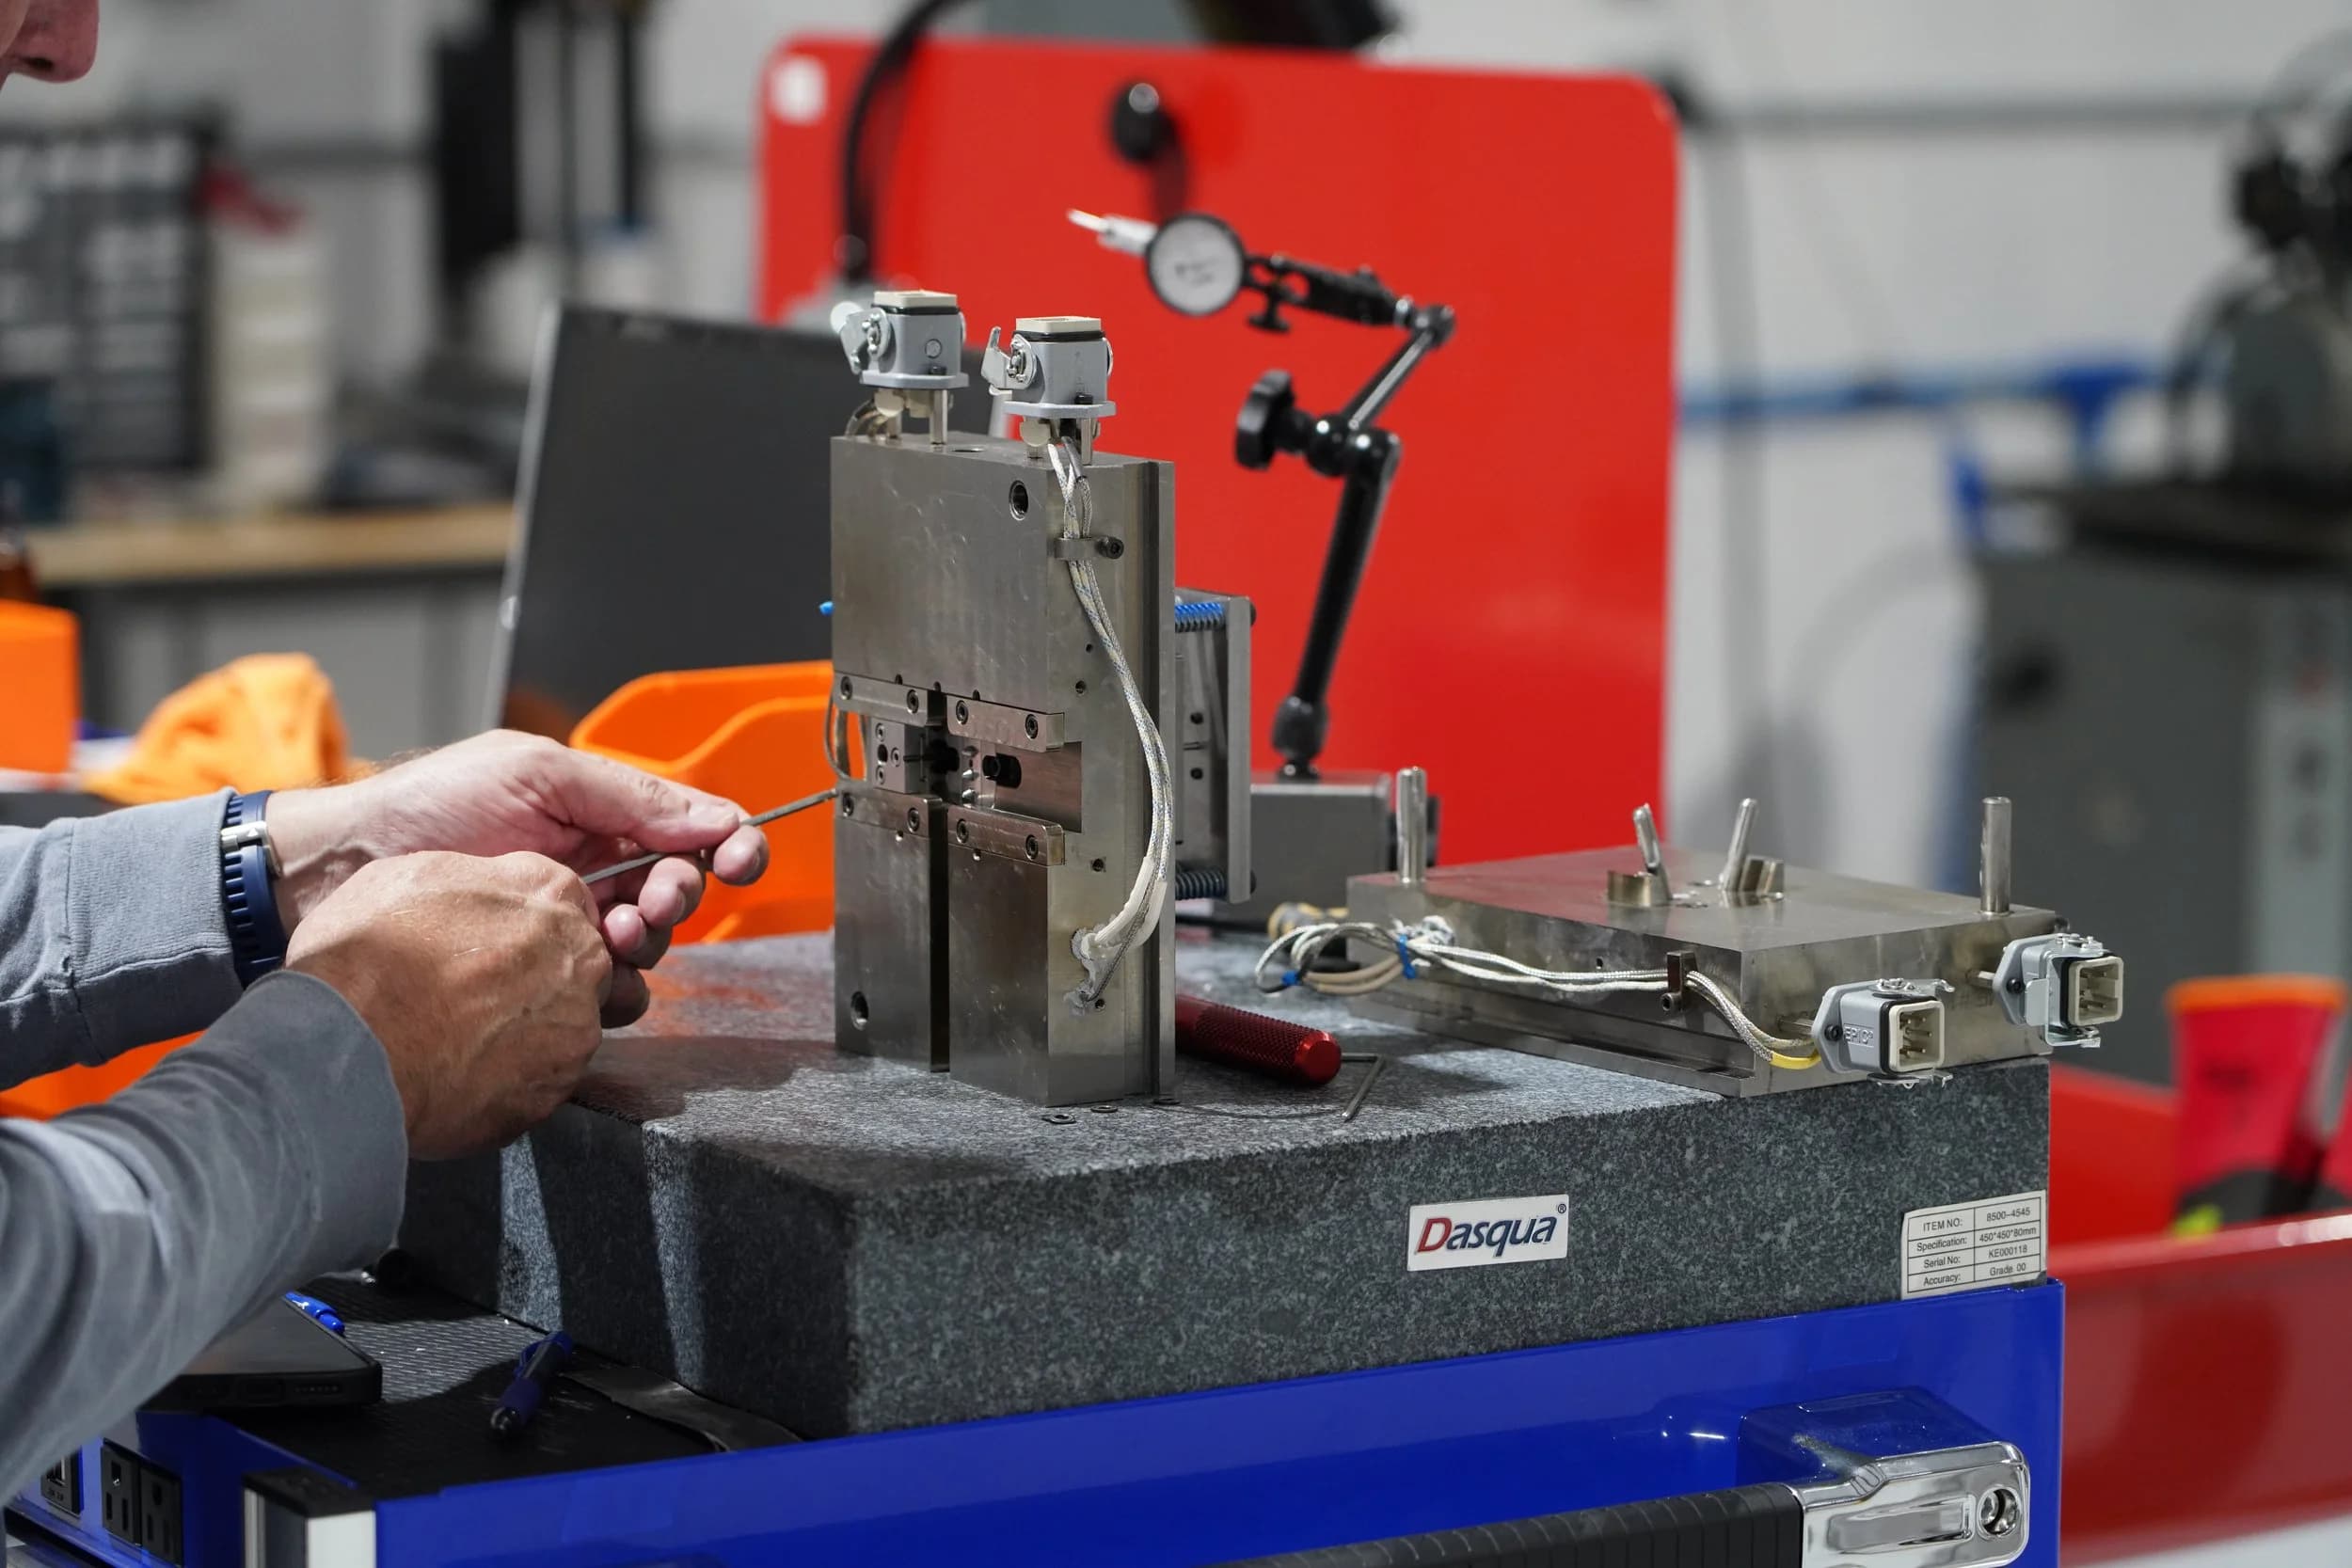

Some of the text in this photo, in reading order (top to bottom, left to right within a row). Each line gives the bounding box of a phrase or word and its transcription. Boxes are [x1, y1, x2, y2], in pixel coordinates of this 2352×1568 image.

[1923, 1220, 1945, 1232] ITEM
[1947, 1218, 1963, 1227] NO:
[1416, 1216, 1558, 1258] Dasqua
[1916, 1237, 1967, 1252] Specification:
[1924, 1257, 1946, 1268] Serial
[1947, 1256, 1961, 1265] No:
[1923, 1274, 1962, 1286] Accuracy:
[2016, 1262, 2026, 1272] 00
